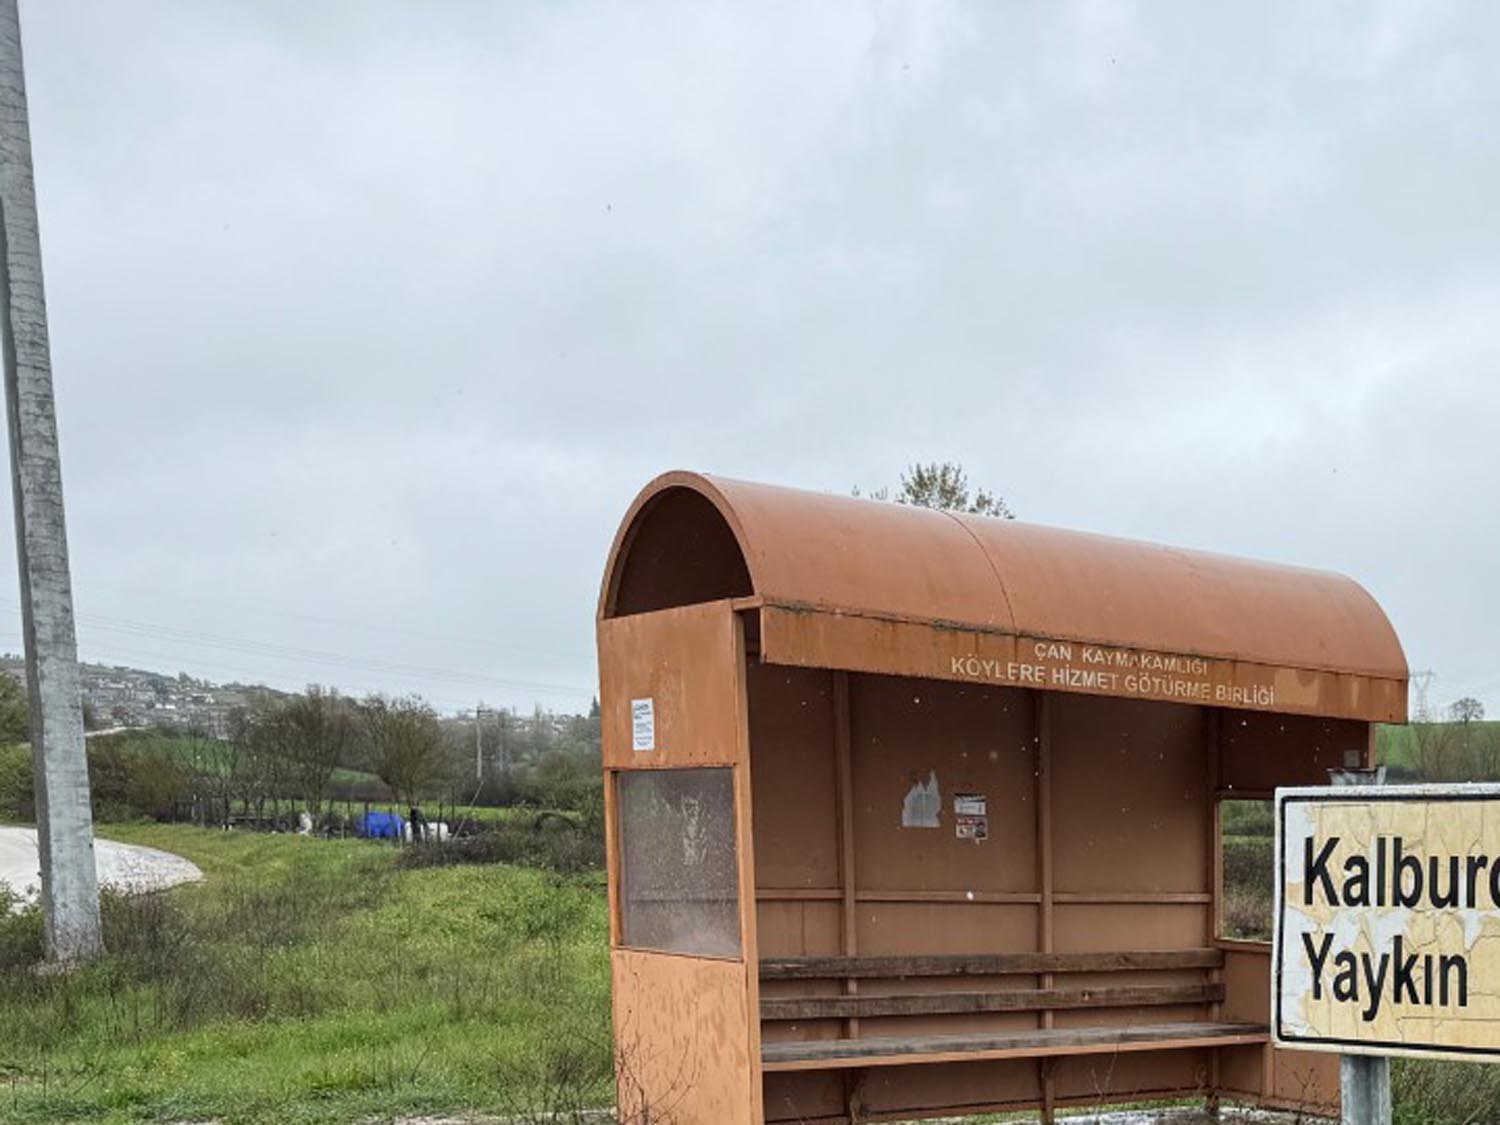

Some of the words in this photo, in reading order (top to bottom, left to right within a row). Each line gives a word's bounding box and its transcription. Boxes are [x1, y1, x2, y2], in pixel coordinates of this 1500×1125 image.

[1034, 643, 1072, 661] ÇAN
[951, 653, 1046, 682] KÖYLERE
[1052, 663, 1119, 690] HİZMET
[1124, 672, 1211, 699] GÖTÜRME
[1215, 680, 1275, 705] BİRLİĞİ
[1301, 932, 1468, 1022] Yaykın
